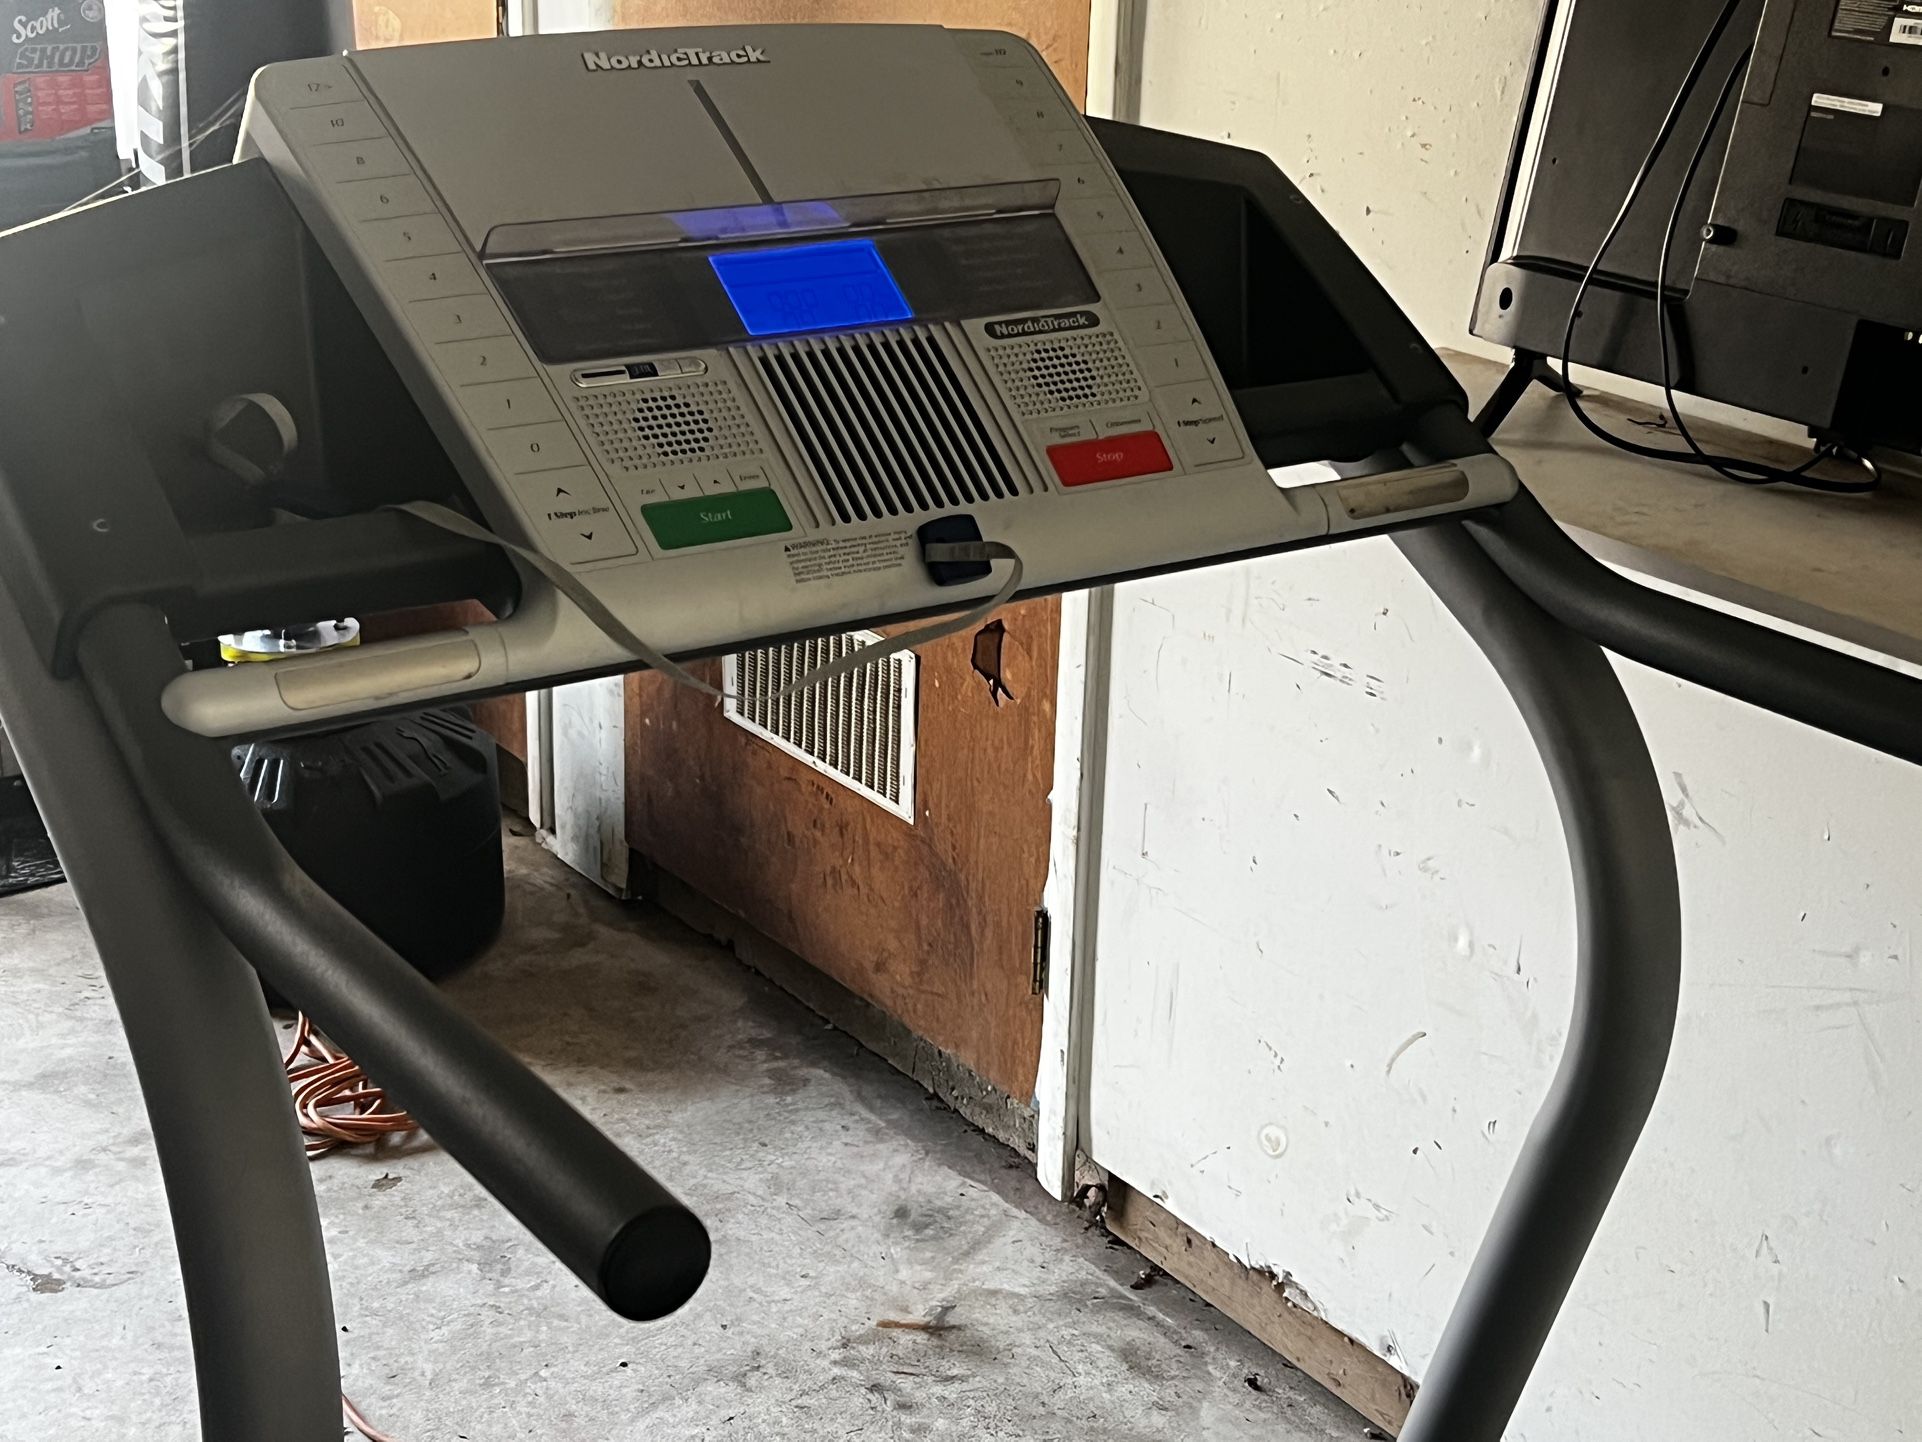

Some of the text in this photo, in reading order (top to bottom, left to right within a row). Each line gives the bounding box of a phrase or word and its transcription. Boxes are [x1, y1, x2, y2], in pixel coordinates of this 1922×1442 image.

[12, 6, 65, 43] Scott
[14, 43, 101, 73] SHOP
[581, 45, 771, 71] NordicTrack
[330, 118, 344, 128] 10
[380, 194, 389, 204] 6
[993, 314, 1089, 337] NordicTrack
[530, 443, 540, 453] 0
[1096, 452, 1124, 464] Stop
[699, 510, 732, 523] Start
